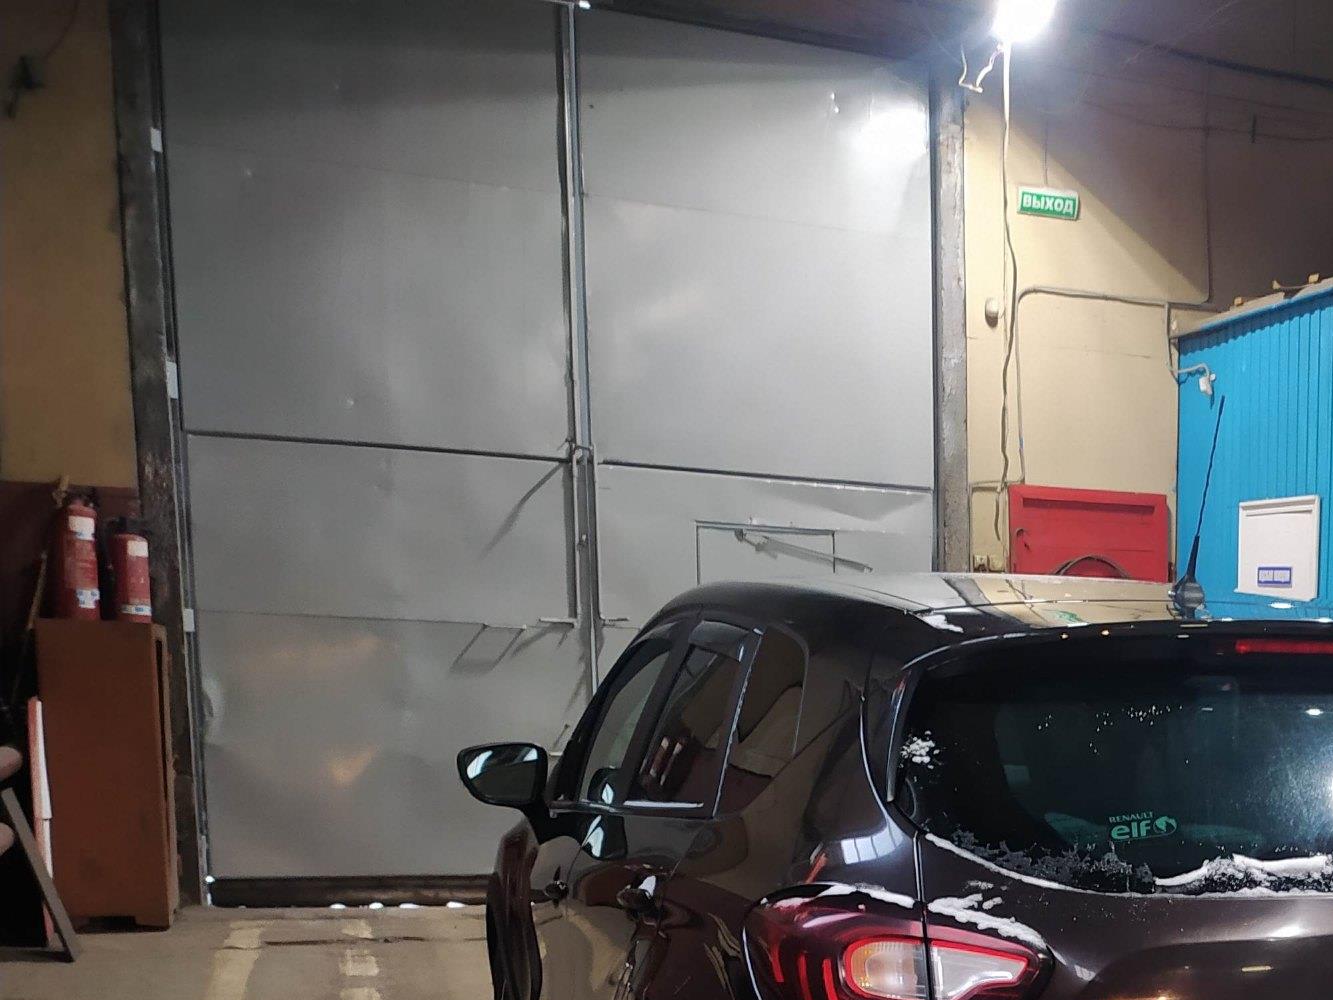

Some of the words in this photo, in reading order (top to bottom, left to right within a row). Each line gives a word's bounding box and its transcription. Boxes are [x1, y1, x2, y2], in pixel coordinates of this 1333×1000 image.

[1022, 193, 1074, 215] ВЫХОД
[1109, 811, 1154, 823] RENAULT
[1111, 820, 1151, 840] elf
